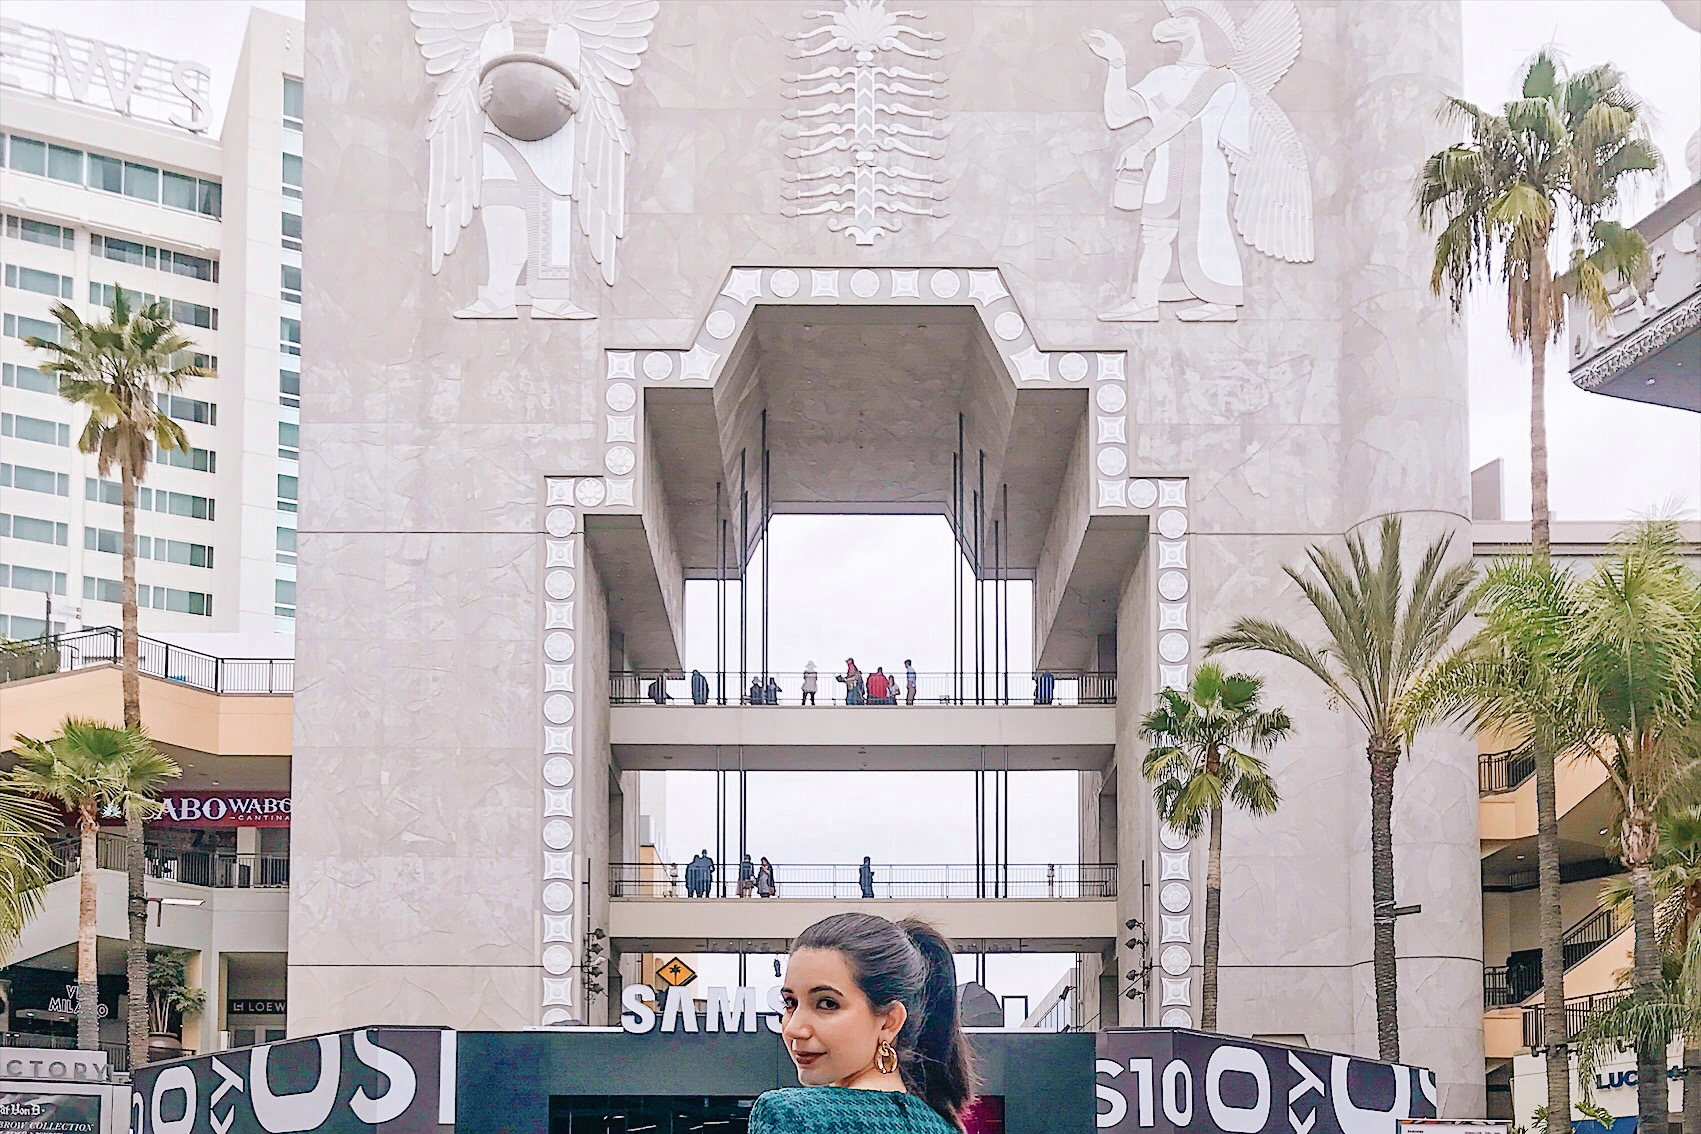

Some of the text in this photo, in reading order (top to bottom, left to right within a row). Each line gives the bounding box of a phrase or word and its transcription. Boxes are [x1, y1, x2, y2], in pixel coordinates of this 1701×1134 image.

[145, 797, 228, 821] ABO
[48, 997, 109, 1018] MILO
[249, 1002, 287, 1012] LOEW
[6, 1059, 107, 1080] CTORY
[1095, 1058, 1194, 1128] S10
[29, 1121, 94, 1132] COLLECTION
